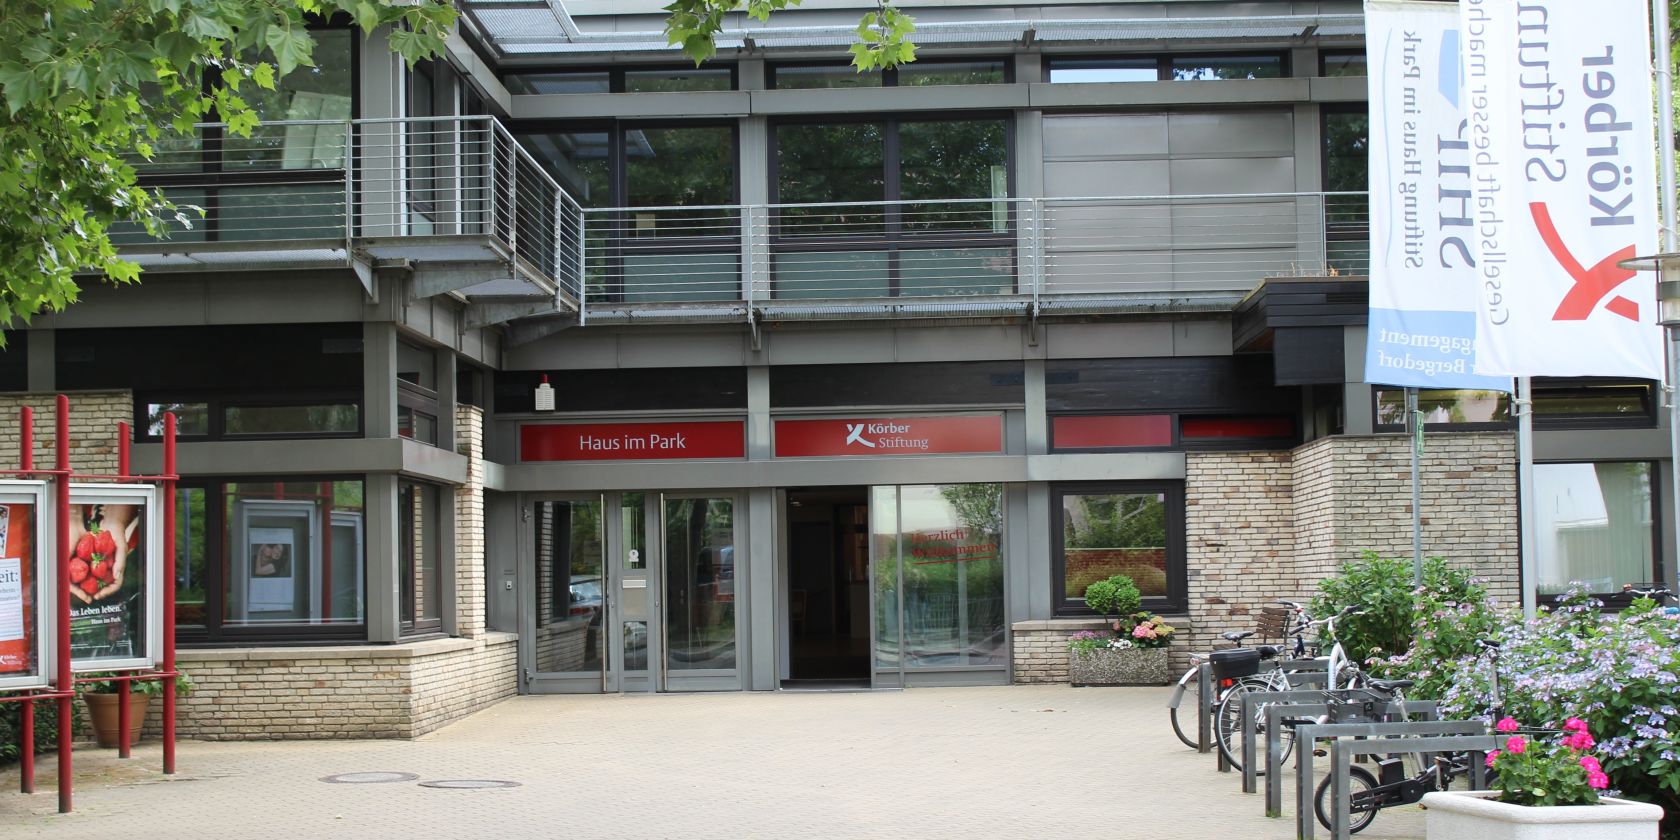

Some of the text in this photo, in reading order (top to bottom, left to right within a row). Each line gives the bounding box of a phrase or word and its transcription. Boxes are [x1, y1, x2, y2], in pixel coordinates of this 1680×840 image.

[868, 422, 911, 434] Körber
[580, 432, 686, 450] Haus im Park
[879, 437, 929, 450] Stiftung
[0, 569, 18, 583] eit:
[80, 606, 100, 616] Leben
